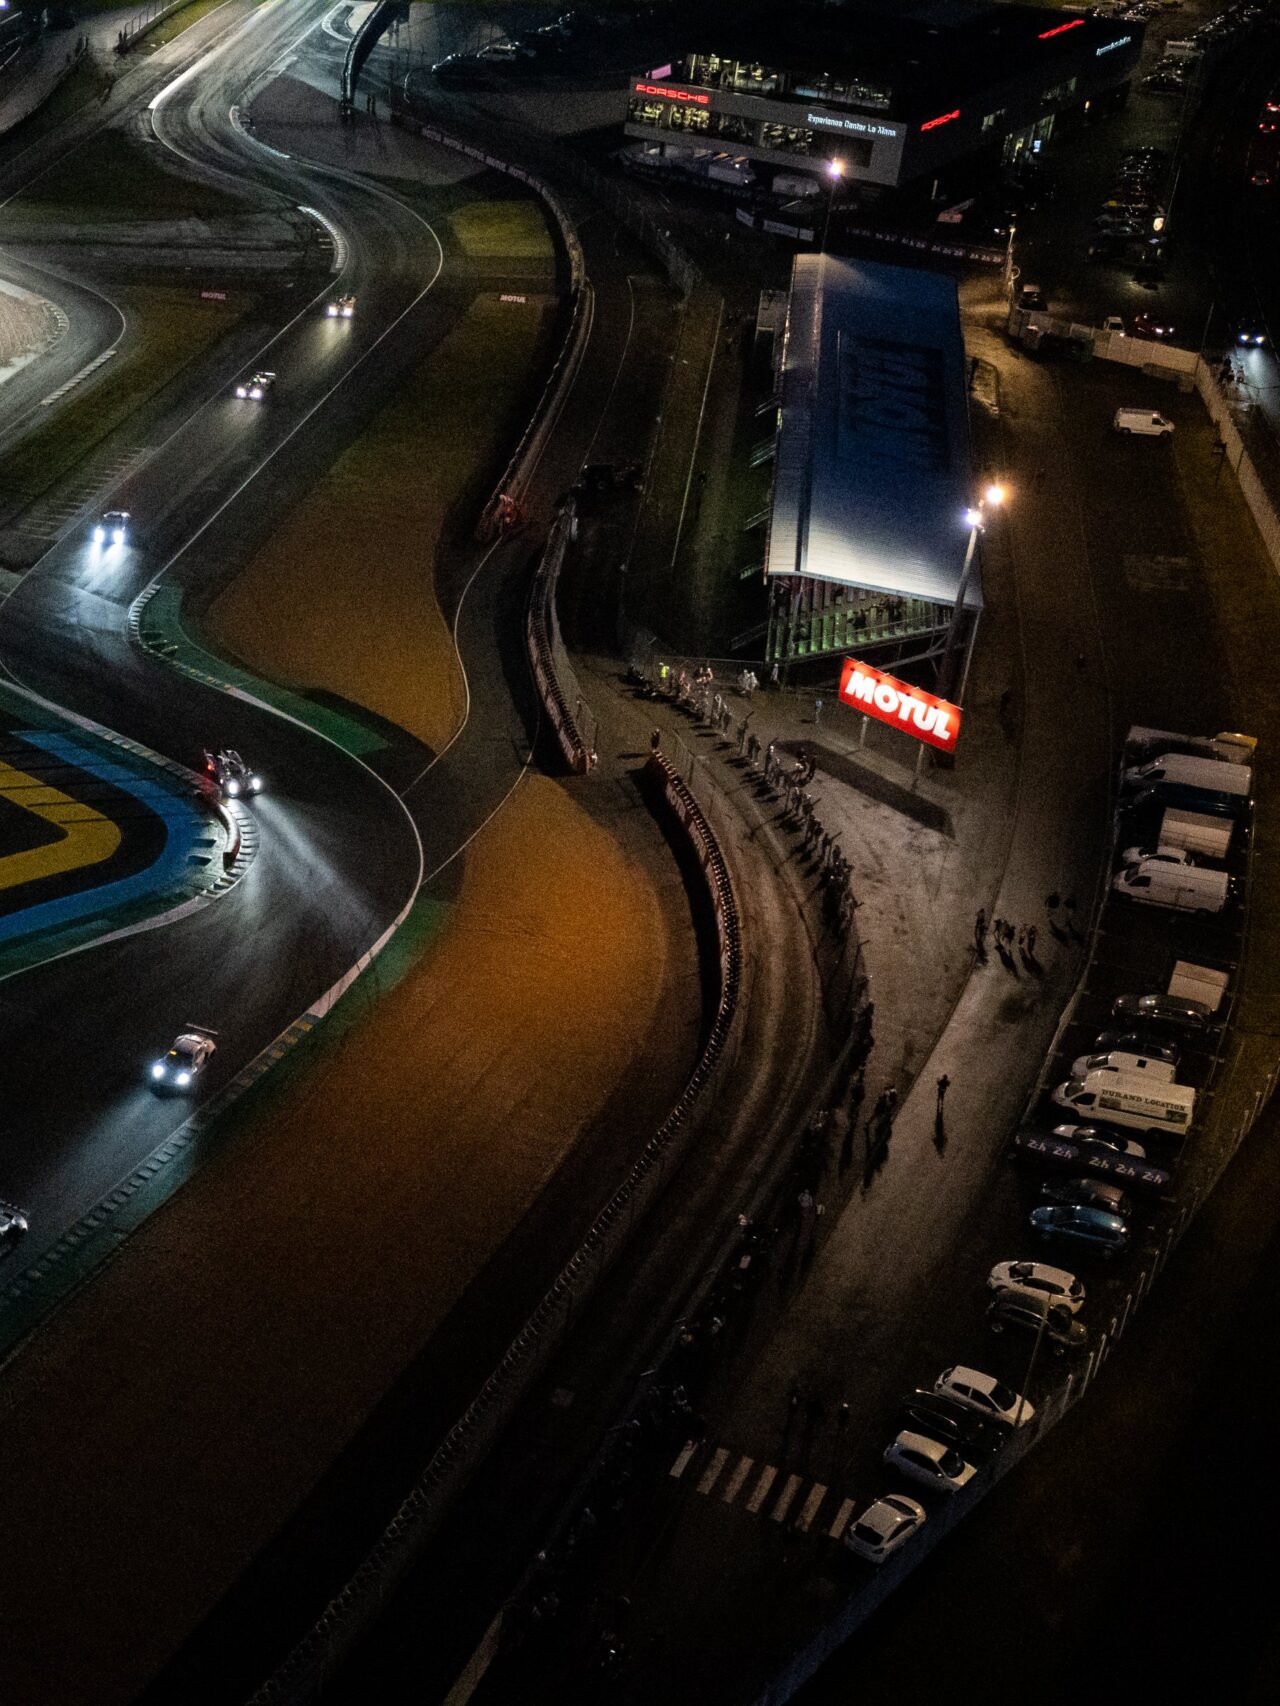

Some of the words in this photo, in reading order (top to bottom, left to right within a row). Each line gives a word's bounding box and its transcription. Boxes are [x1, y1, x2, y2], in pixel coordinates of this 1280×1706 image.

[635, 84, 709, 104] PORSCHE
[807, 113, 843, 127] Experience
[500, 294, 526, 304] MOTUL
[845, 670, 951, 741] MOTUL
[1102, 1089, 1142, 1103] DURAND
[1144, 1096, 1186, 1112] LOCATION
